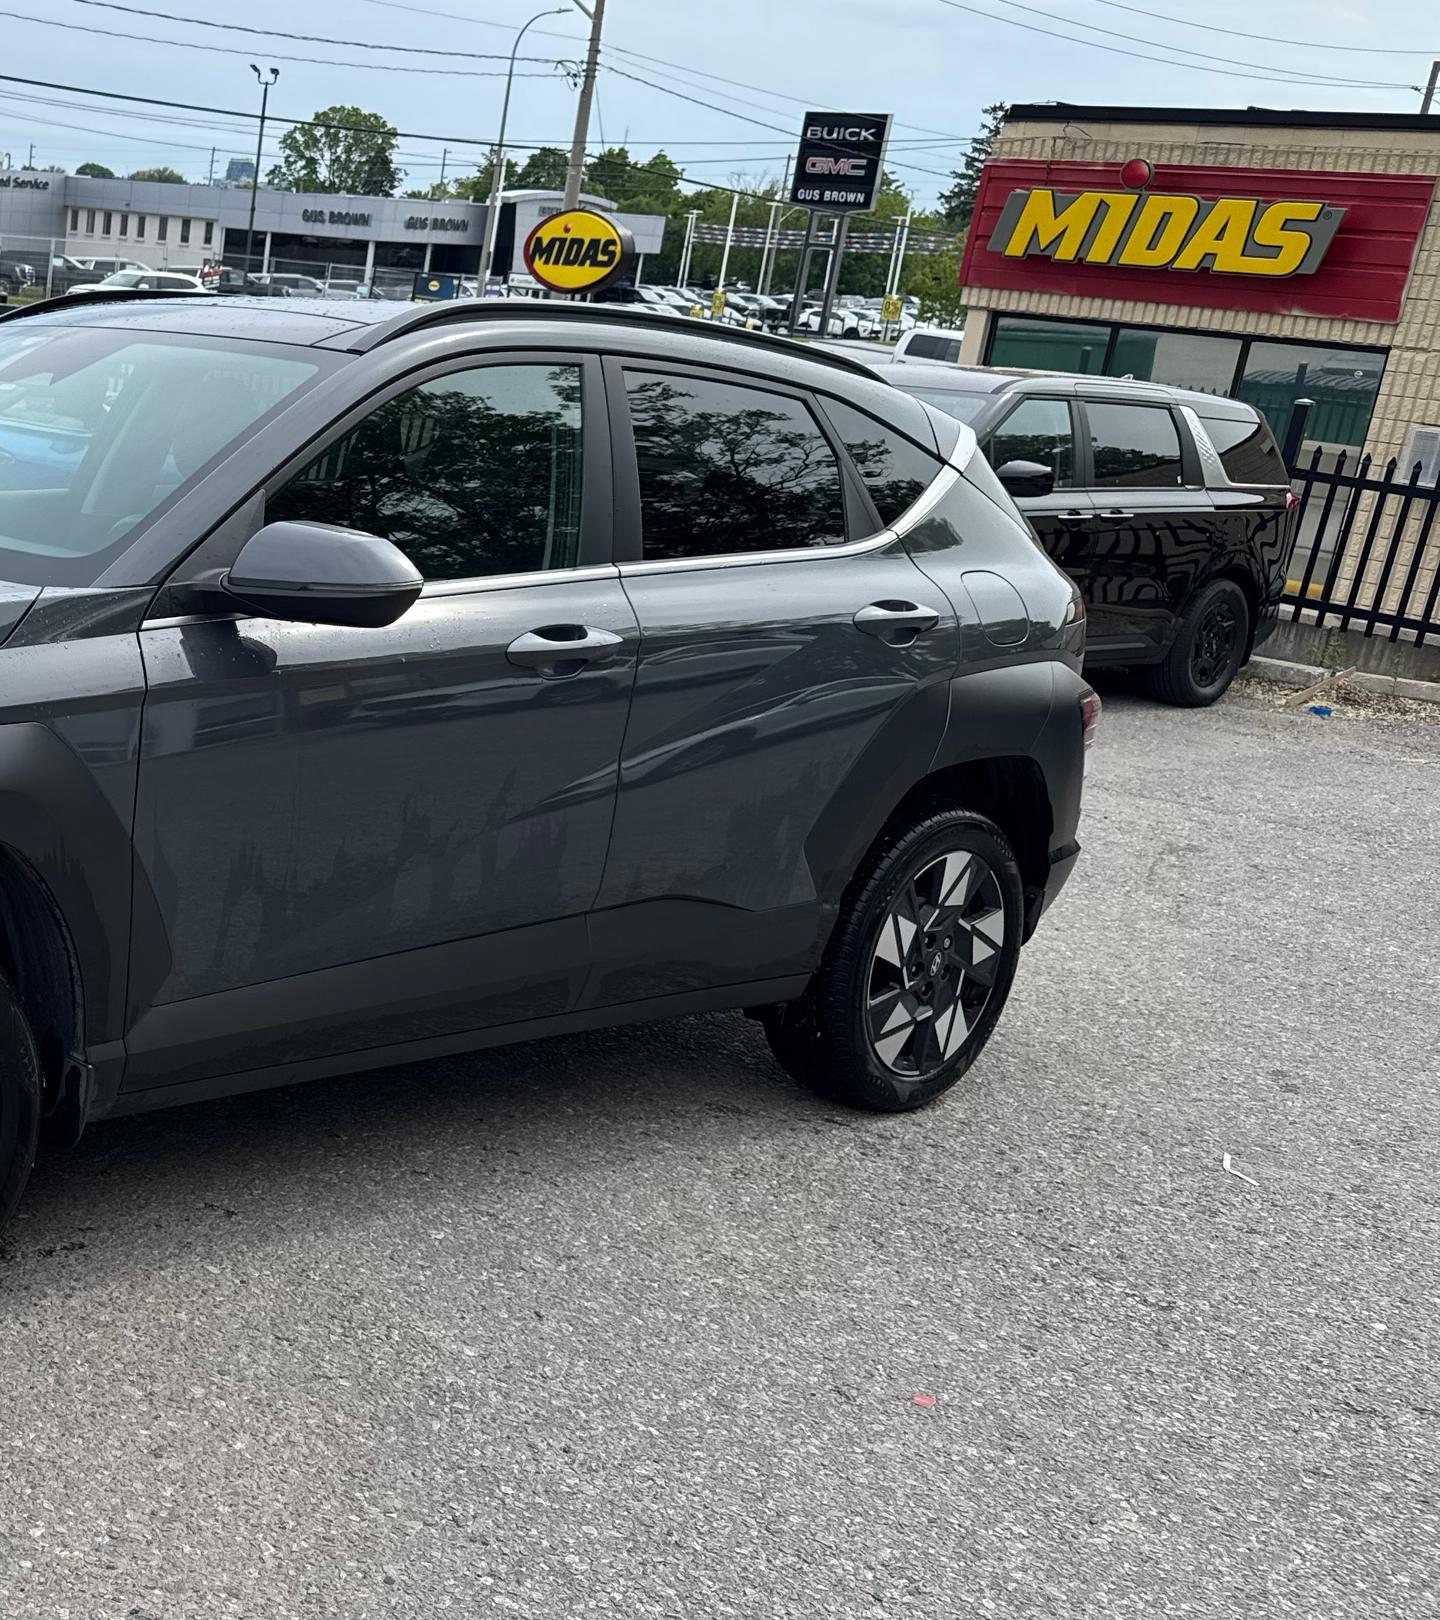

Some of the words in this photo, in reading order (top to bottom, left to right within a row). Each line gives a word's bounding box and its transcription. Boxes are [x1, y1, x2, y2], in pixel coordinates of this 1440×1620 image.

[806, 126, 877, 141] BUICK
[805, 156, 867, 176] GMC
[12, 177, 50, 190] Service
[797, 189, 820, 200] GUS
[824, 190, 865, 203] BROWN
[302, 209, 326, 224] GUS
[328, 210, 371, 227] BROWN
[405, 216, 428, 231] GUS
[430, 217, 470, 232] BROWN
[1003, 187, 1325, 277] MIDAS
[529, 235, 618, 268] MIDAS
